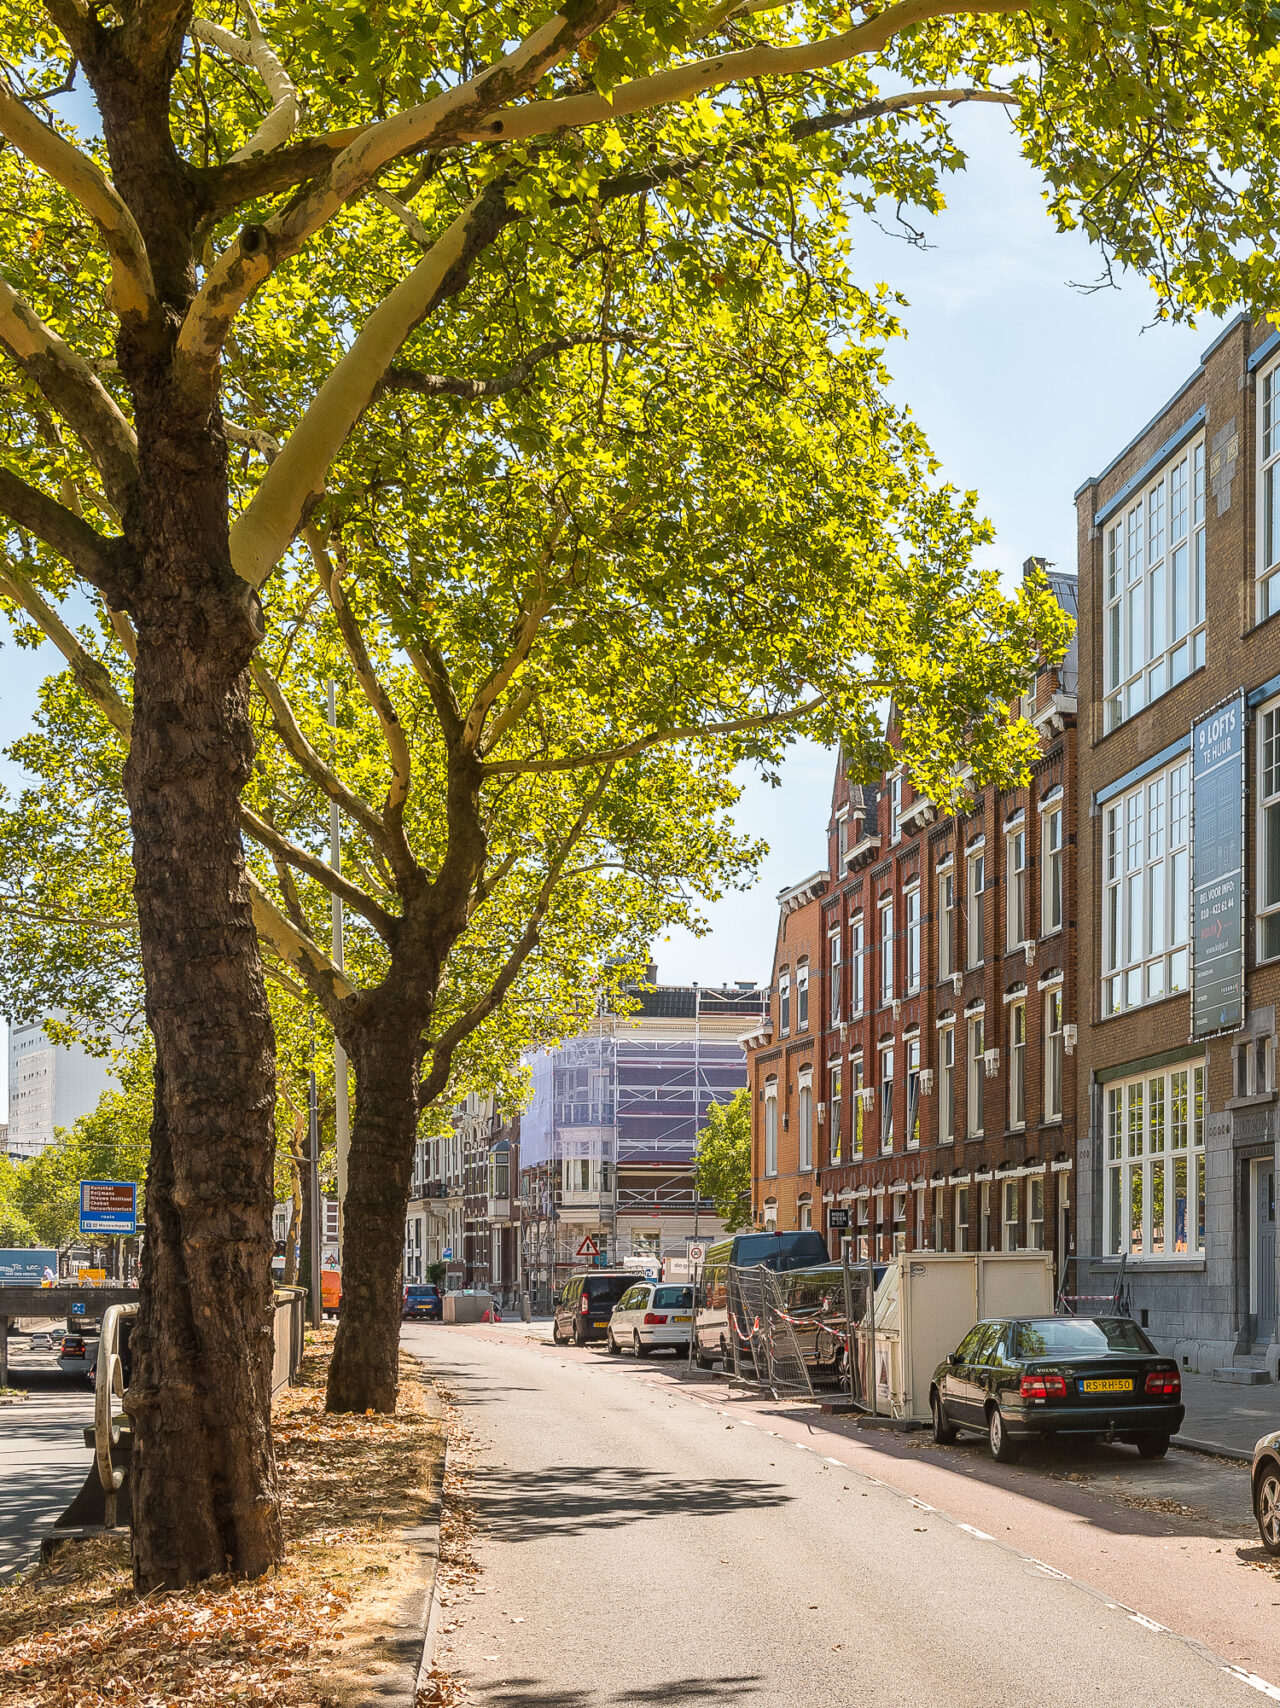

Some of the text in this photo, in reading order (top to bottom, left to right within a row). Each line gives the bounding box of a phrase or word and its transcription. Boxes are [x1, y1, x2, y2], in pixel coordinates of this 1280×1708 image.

[1199, 708, 1236, 751] 9 LOFTS
[1203, 736, 1232, 765] TE HUUR
[1200, 880, 1235, 905] BEL VOOR INFO:
[1200, 907, 1209, 920] 010
[1228, 897, 1234, 908] 44
[1086, 1380, 1130, 1390] RS-RH-50
